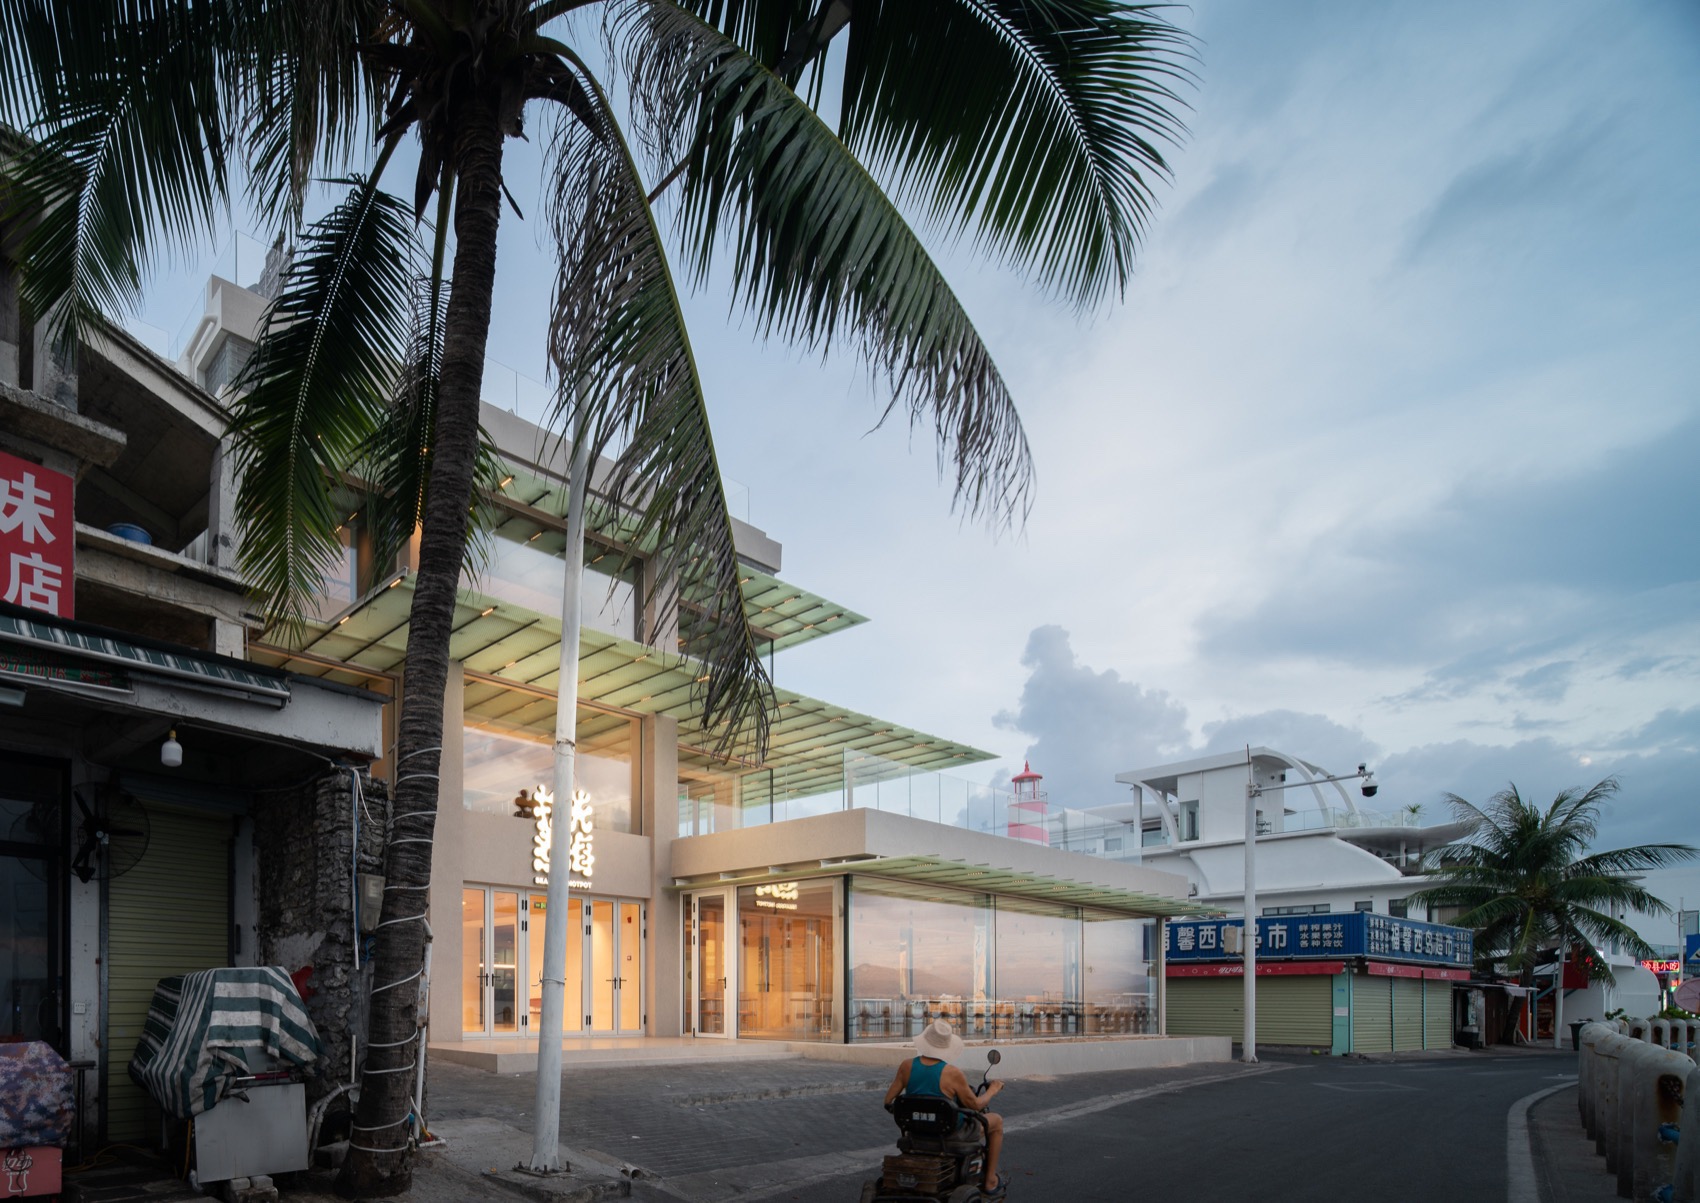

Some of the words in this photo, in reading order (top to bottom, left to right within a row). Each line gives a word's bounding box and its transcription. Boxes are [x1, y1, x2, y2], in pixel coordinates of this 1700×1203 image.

[3, 552, 63, 617] 店
[1391, 923, 1452, 956] 福馨西岛超市
